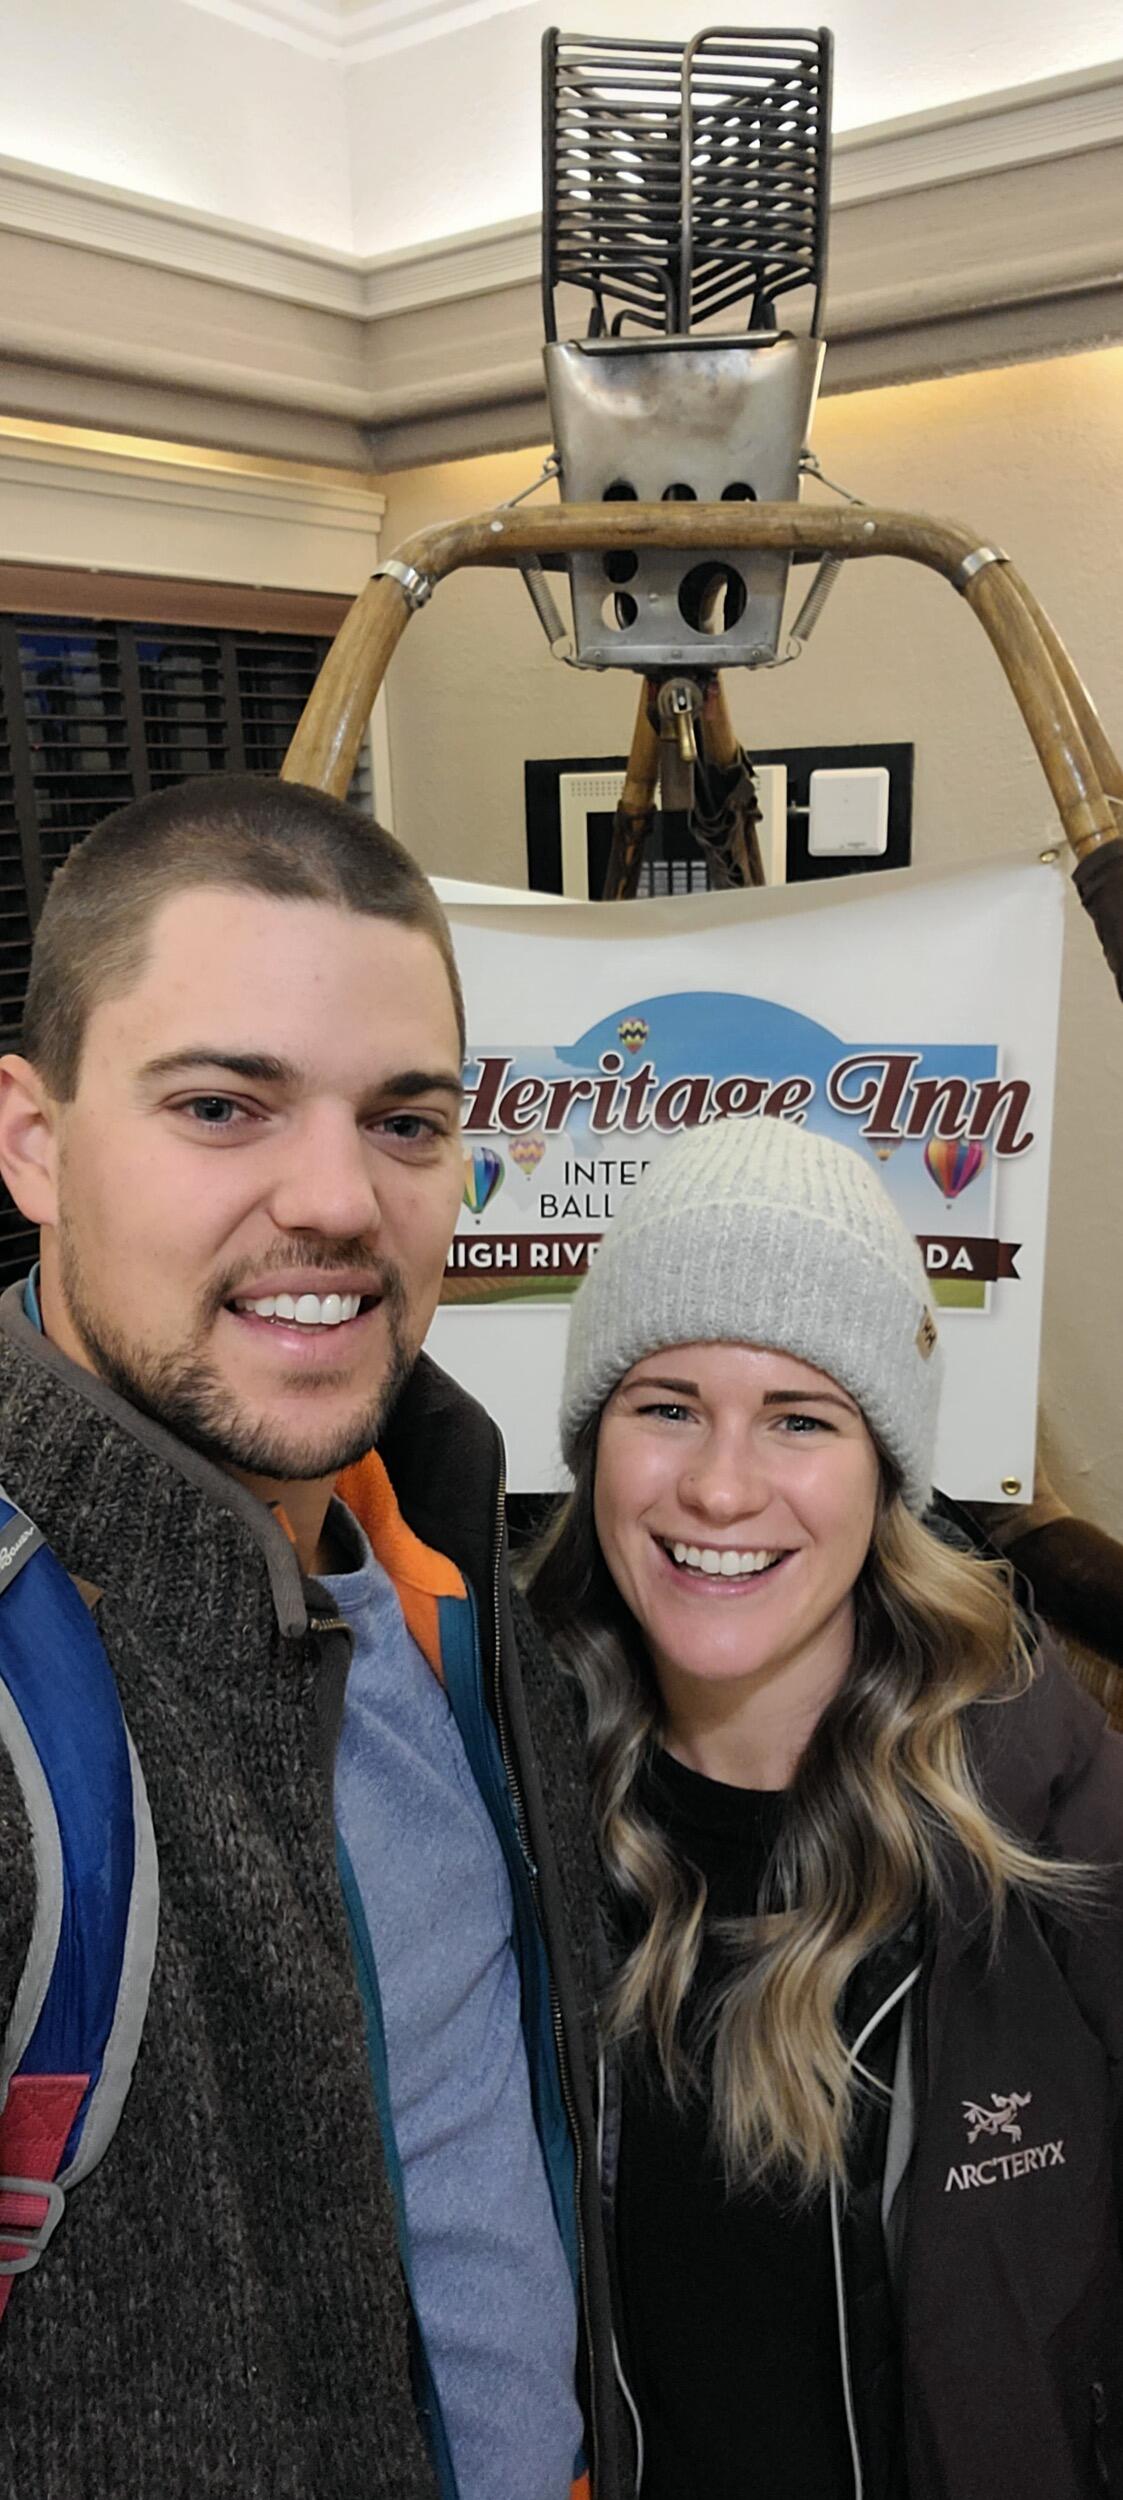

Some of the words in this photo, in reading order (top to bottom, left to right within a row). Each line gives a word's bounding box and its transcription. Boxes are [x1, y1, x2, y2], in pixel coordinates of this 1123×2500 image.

[829, 1055, 1034, 1154] Inn
[565, 1161, 651, 1185] INTE
[944, 2140, 1066, 2192] ARC'TERYX
